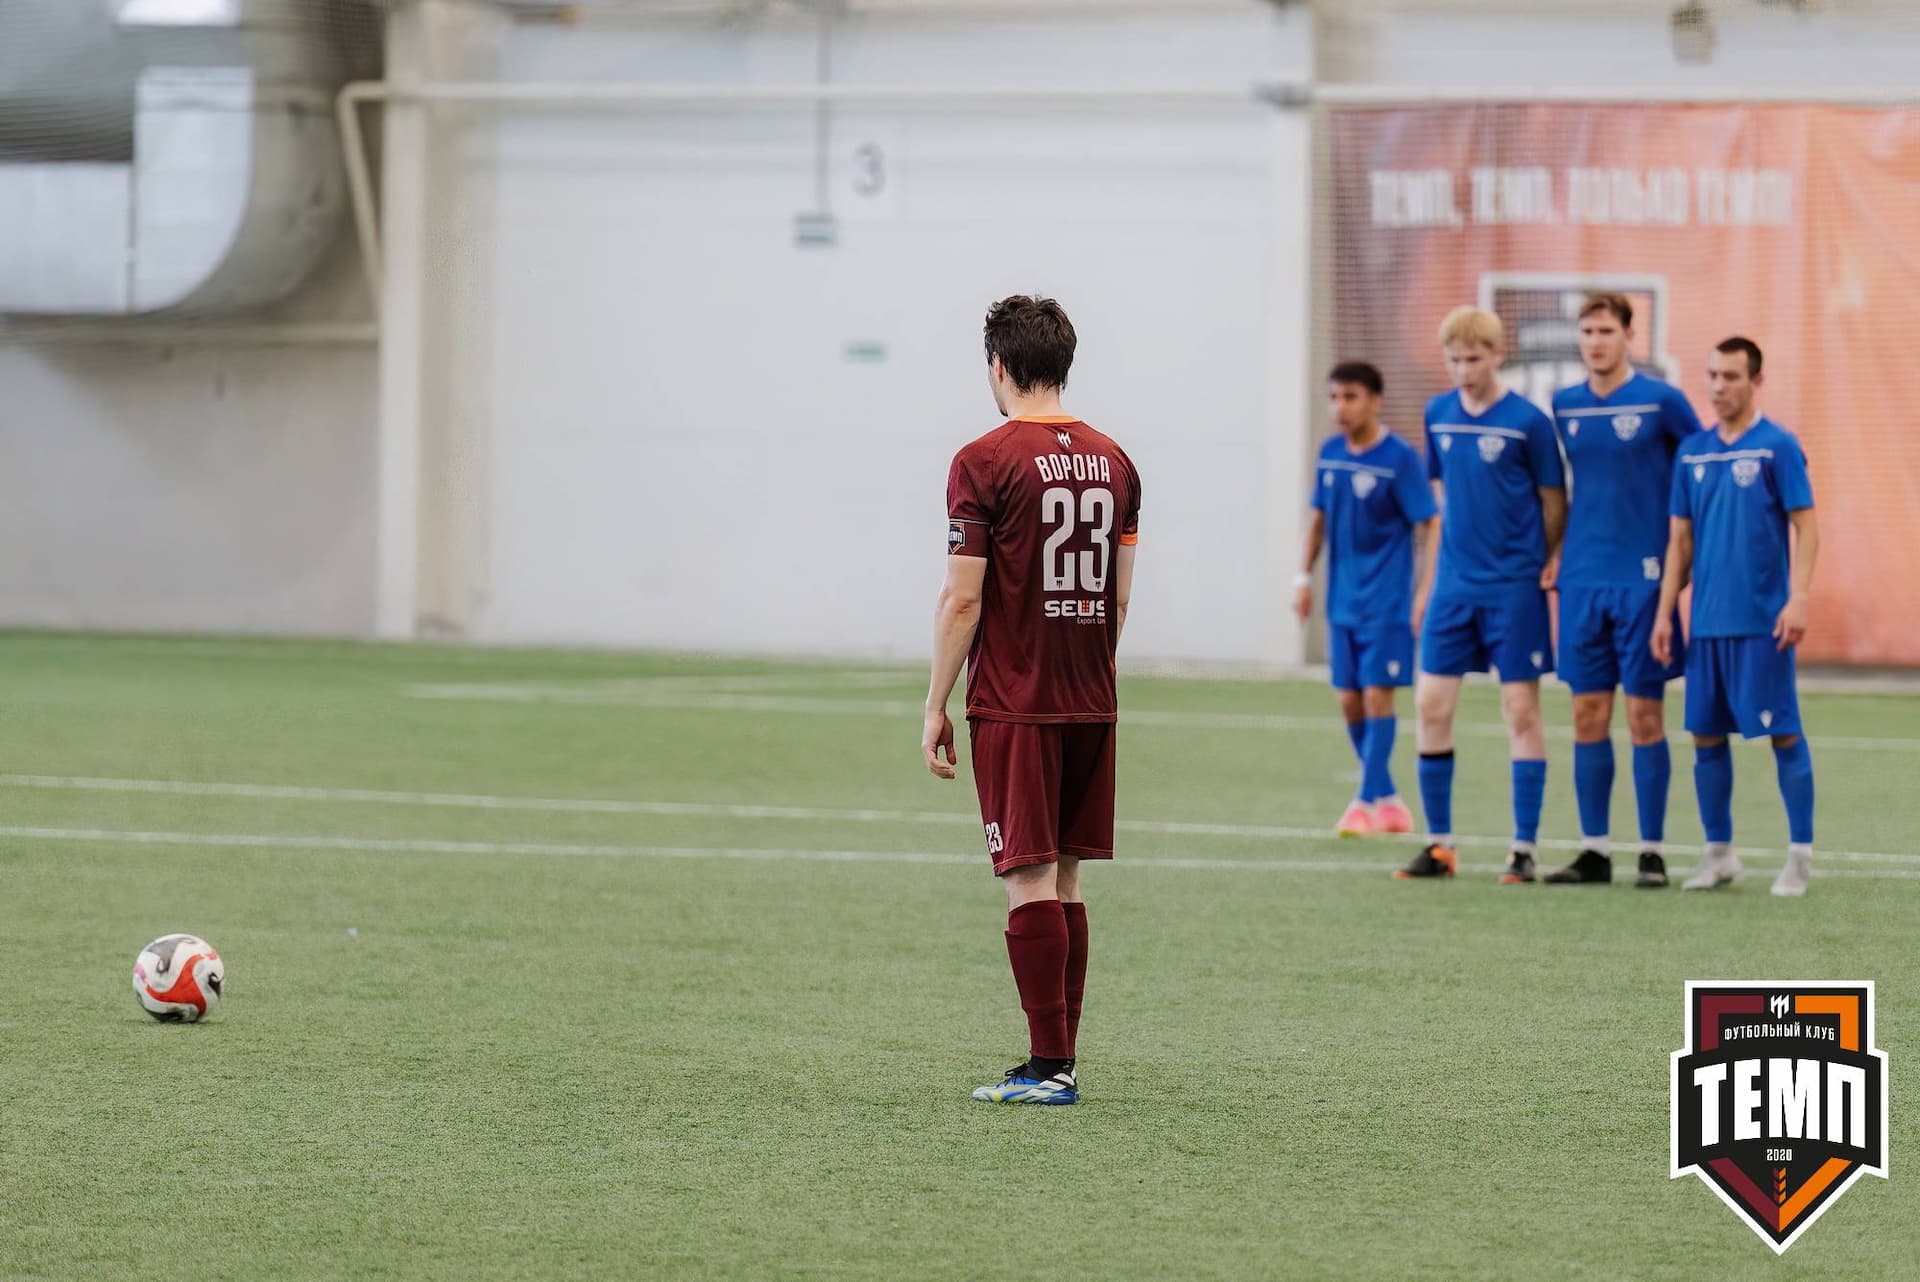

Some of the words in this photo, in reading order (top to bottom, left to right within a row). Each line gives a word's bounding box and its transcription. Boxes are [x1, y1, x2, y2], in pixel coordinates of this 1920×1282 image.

[852, 142, 885, 197] 3
[1034, 453, 1111, 483] ВОРОНА
[1041, 487, 1114, 592] 23
[985, 821, 1003, 853] 23
